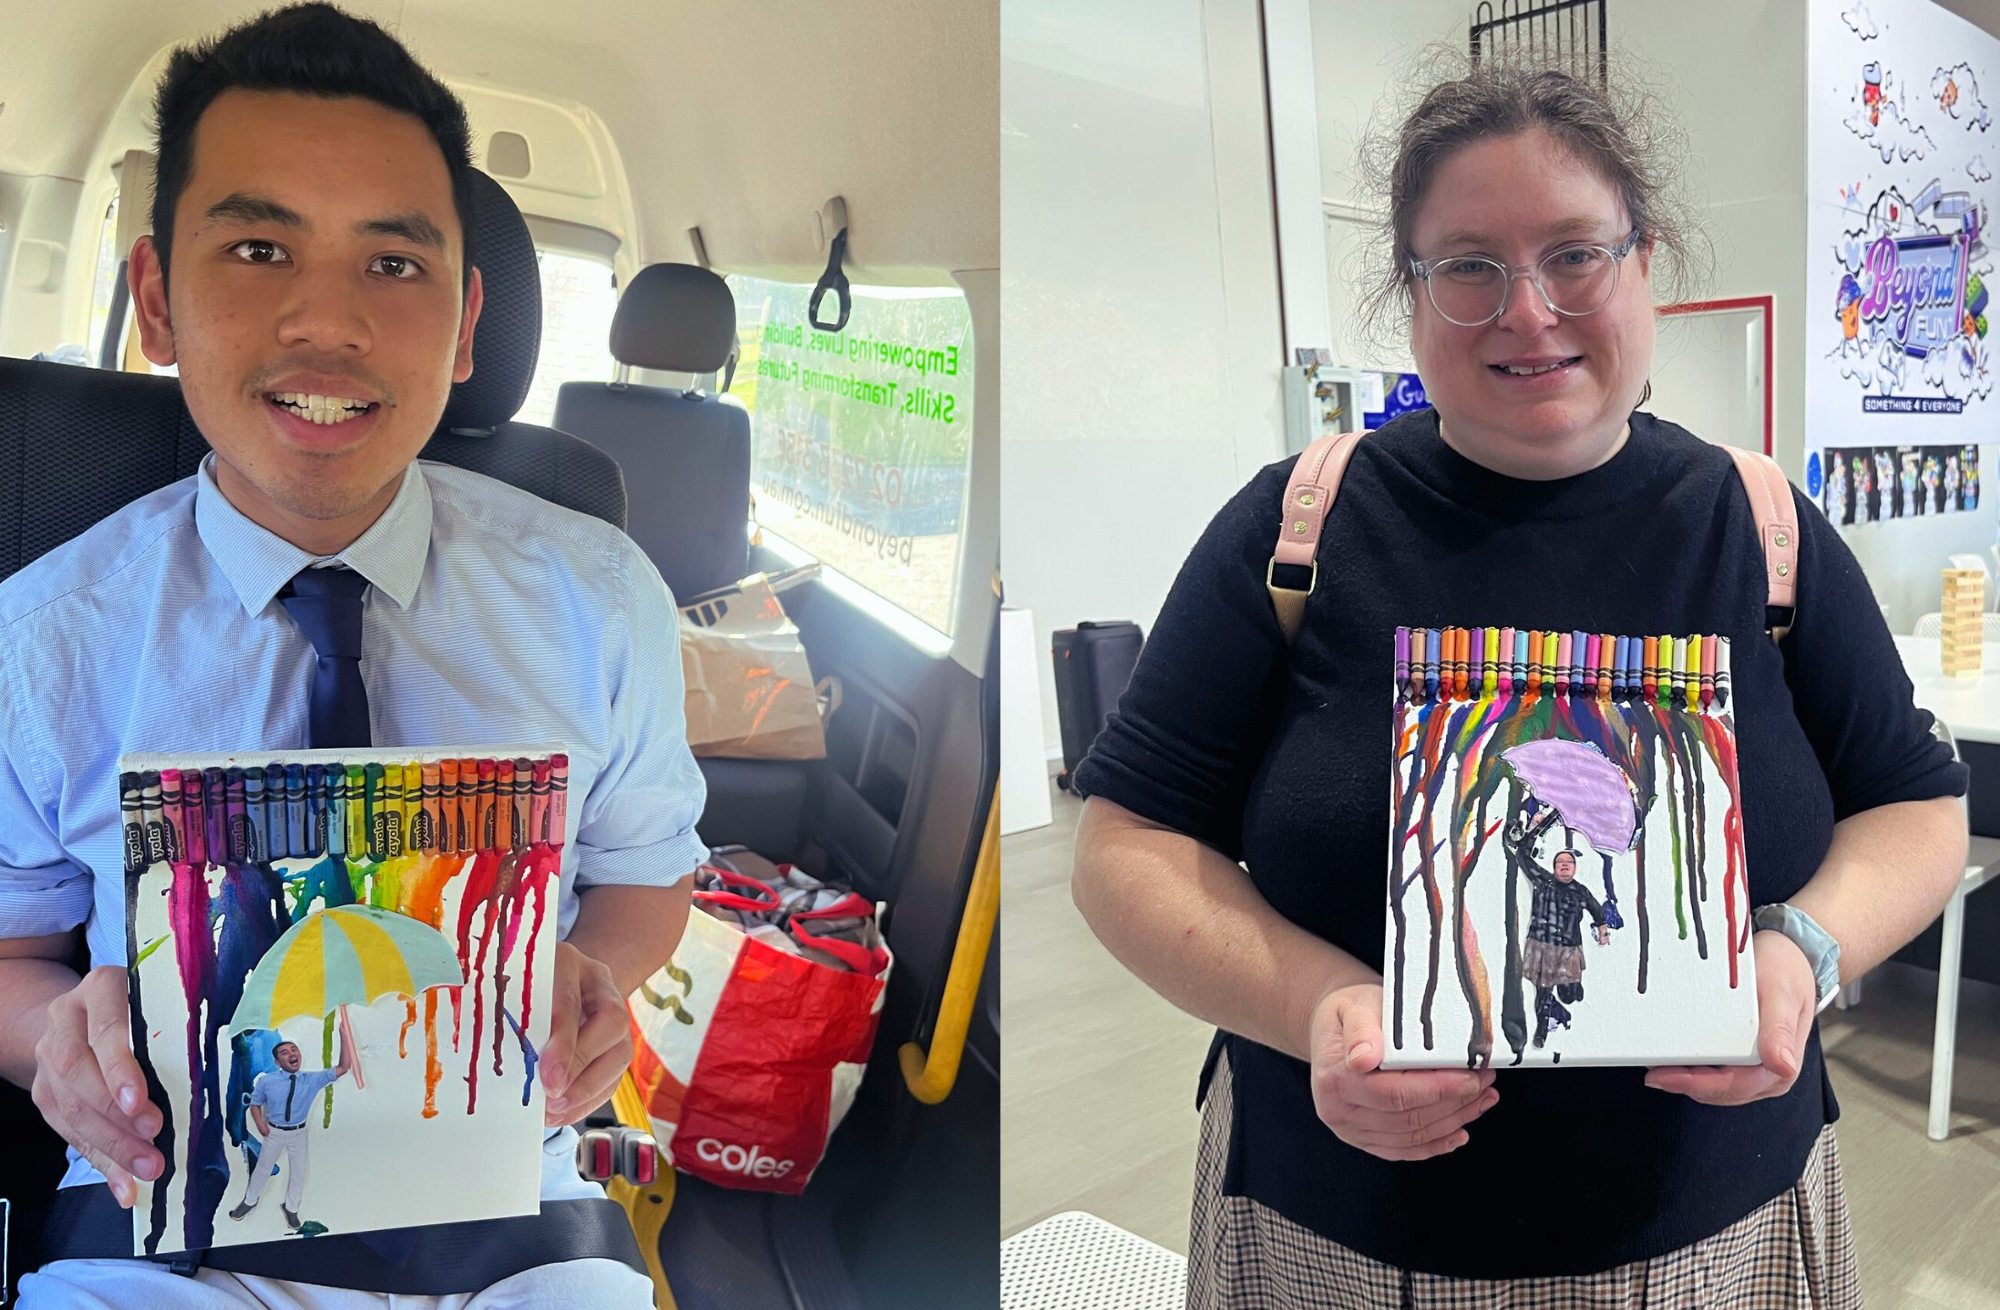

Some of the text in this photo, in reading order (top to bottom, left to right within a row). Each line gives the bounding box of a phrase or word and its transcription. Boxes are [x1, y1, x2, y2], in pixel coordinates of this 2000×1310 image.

[1860, 237, 1957, 344] Beyond
[1915, 313, 1950, 340] FUN
[1864, 398, 1961, 413] SOMETHING 4 EVERYONE
[128, 830, 144, 866] ayola
[232, 821, 246, 856] ayola
[386, 818, 401, 857] rayola
[696, 1137, 795, 1180] coles
